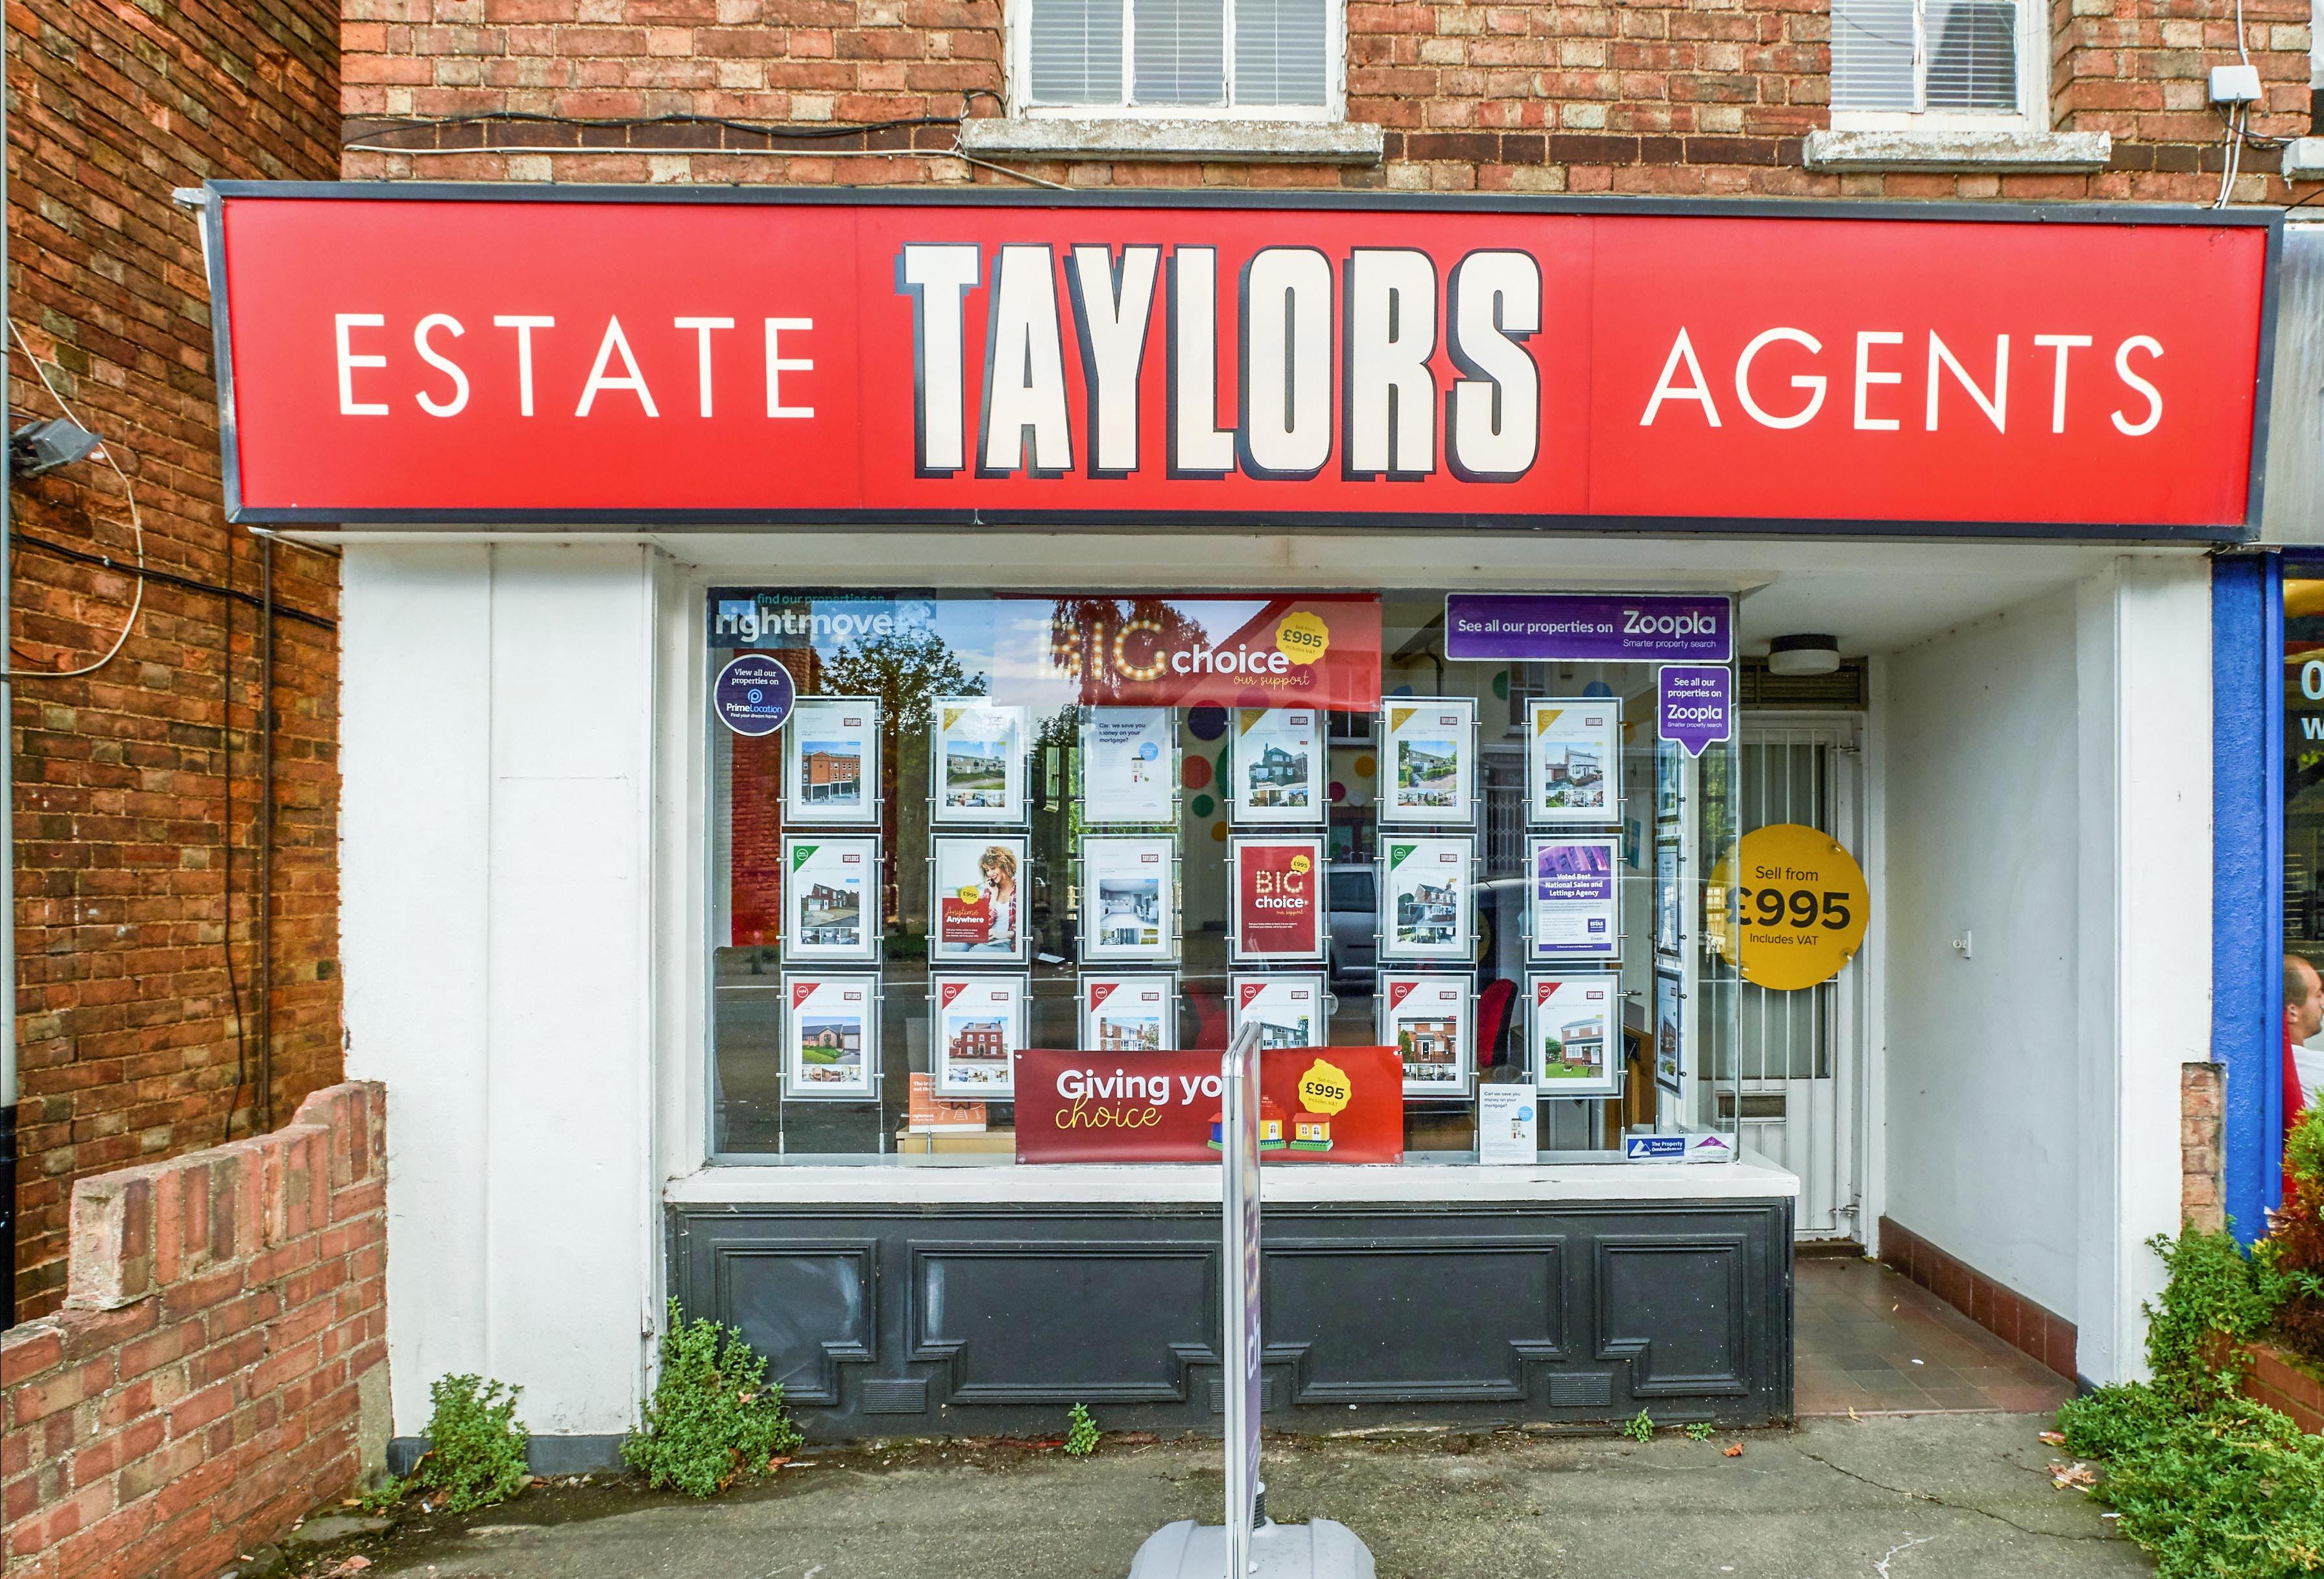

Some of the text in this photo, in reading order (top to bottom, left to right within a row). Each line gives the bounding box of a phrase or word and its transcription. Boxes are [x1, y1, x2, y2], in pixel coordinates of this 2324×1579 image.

[334, 313, 815, 419] ESTATE
[894, 241, 1542, 482] TAYLORS
[1639, 326, 2165, 437] AGENTS
[758, 594, 779, 604] find
[805, 594, 867, 607] properties
[715, 607, 893, 642] rightmove
[1459, 620, 1613, 634] See all our properties on
[1623, 610, 1716, 639] Zoopla
[1283, 629, 1323, 648] £995
[1623, 638, 1654, 647] Smarter
[1656, 640, 1688, 649] property
[1039, 618, 1168, 682] BIG
[1171, 643, 1289, 674] choice
[1234, 670, 1310, 691] our support
[1674, 677, 1689, 686] See
[1691, 677, 1700, 686] all
[1668, 689, 1710, 698] properties
[726, 703, 783, 714] PrimeLocation
[1668, 705, 1722, 722] Zoopla
[1256, 870, 1304, 893] BIG
[1755, 866, 1819, 882] Sell from
[1255, 895, 1304, 908] choice
[1725, 886, 1851, 930] £995
[946, 915, 985, 924] Anywhere
[1750, 933, 1819, 946] Includes VAT
[1056, 1068, 1223, 1106] Giving yo
[1305, 1081, 1345, 1100] £995
[1055, 1091, 1162, 1129] choice
